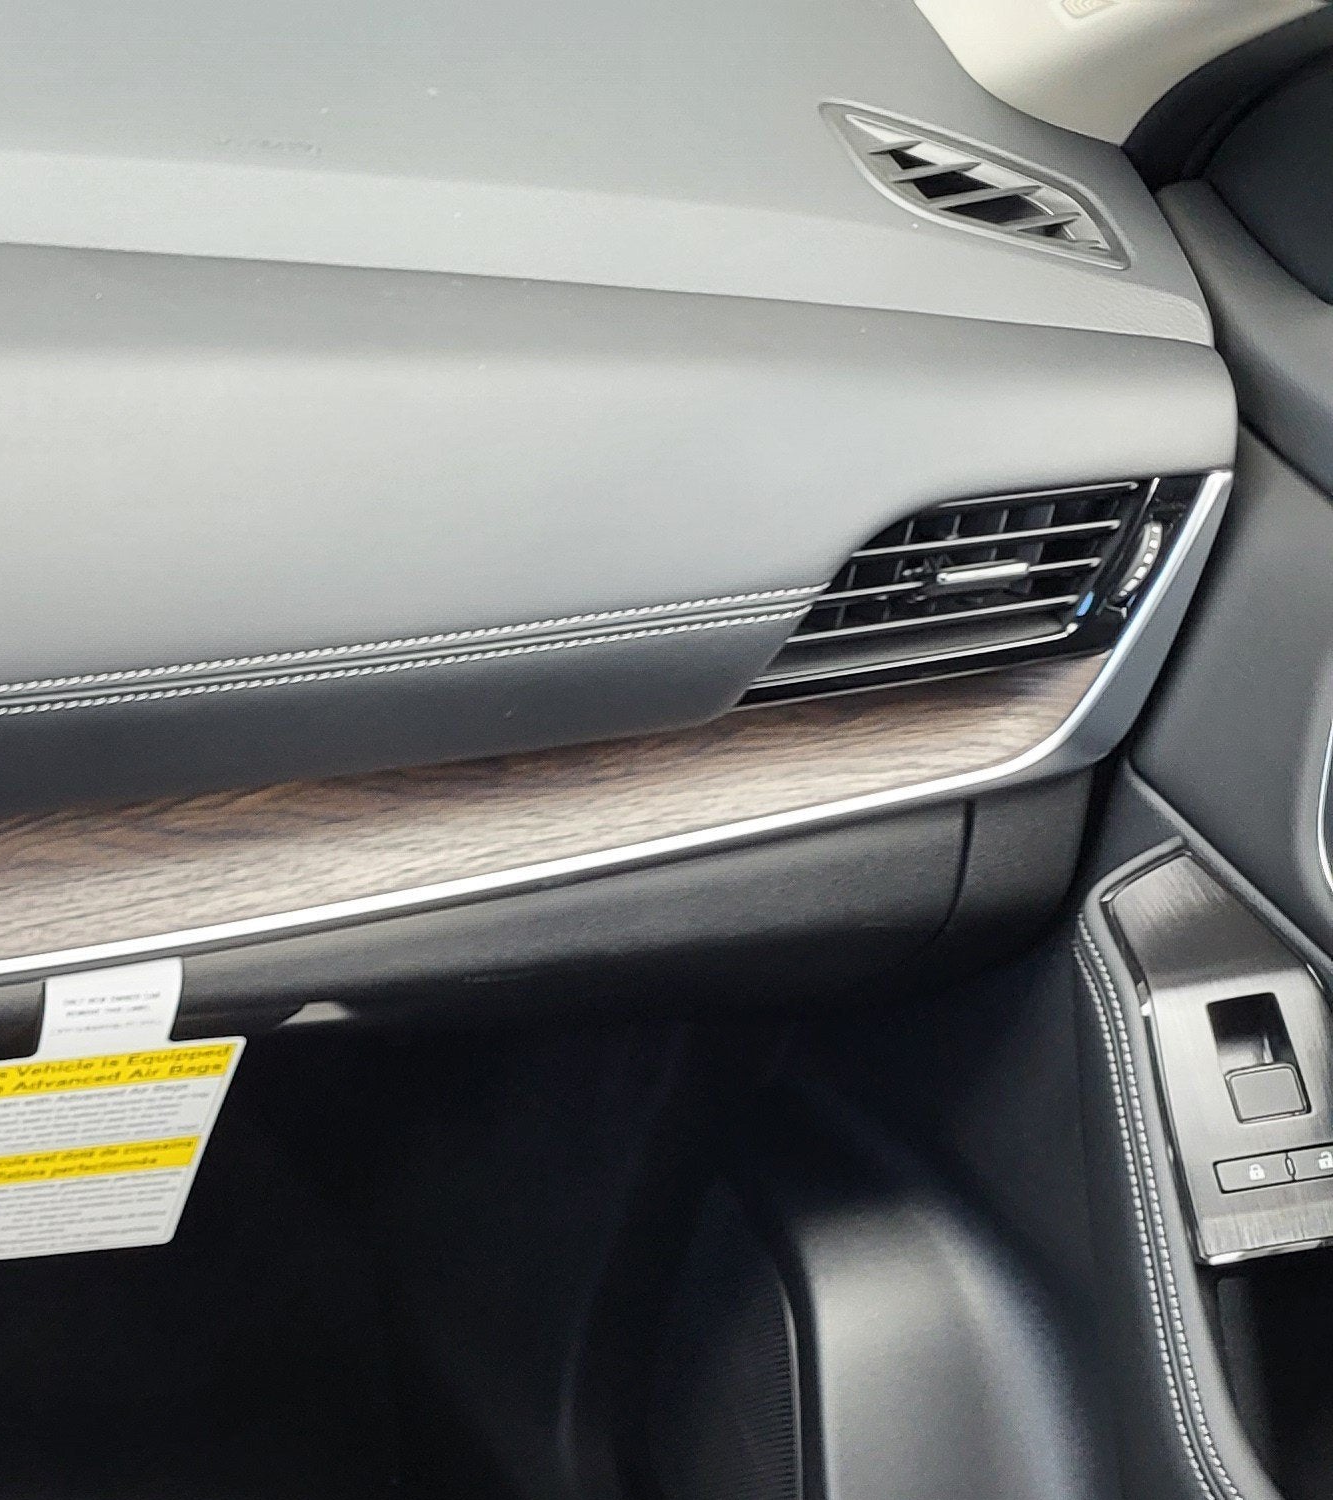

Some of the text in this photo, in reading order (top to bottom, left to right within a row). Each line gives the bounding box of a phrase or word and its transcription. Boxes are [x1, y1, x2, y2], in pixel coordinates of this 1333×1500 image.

[13, 1071, 122, 1092] Advanced
[129, 1067, 159, 1079] Air
[168, 1061, 224, 1077] Bags
[17, 1060, 94, 1079] Vehicle
[101, 1057, 119, 1069] is
[126, 1045, 232, 1068] Equipped
